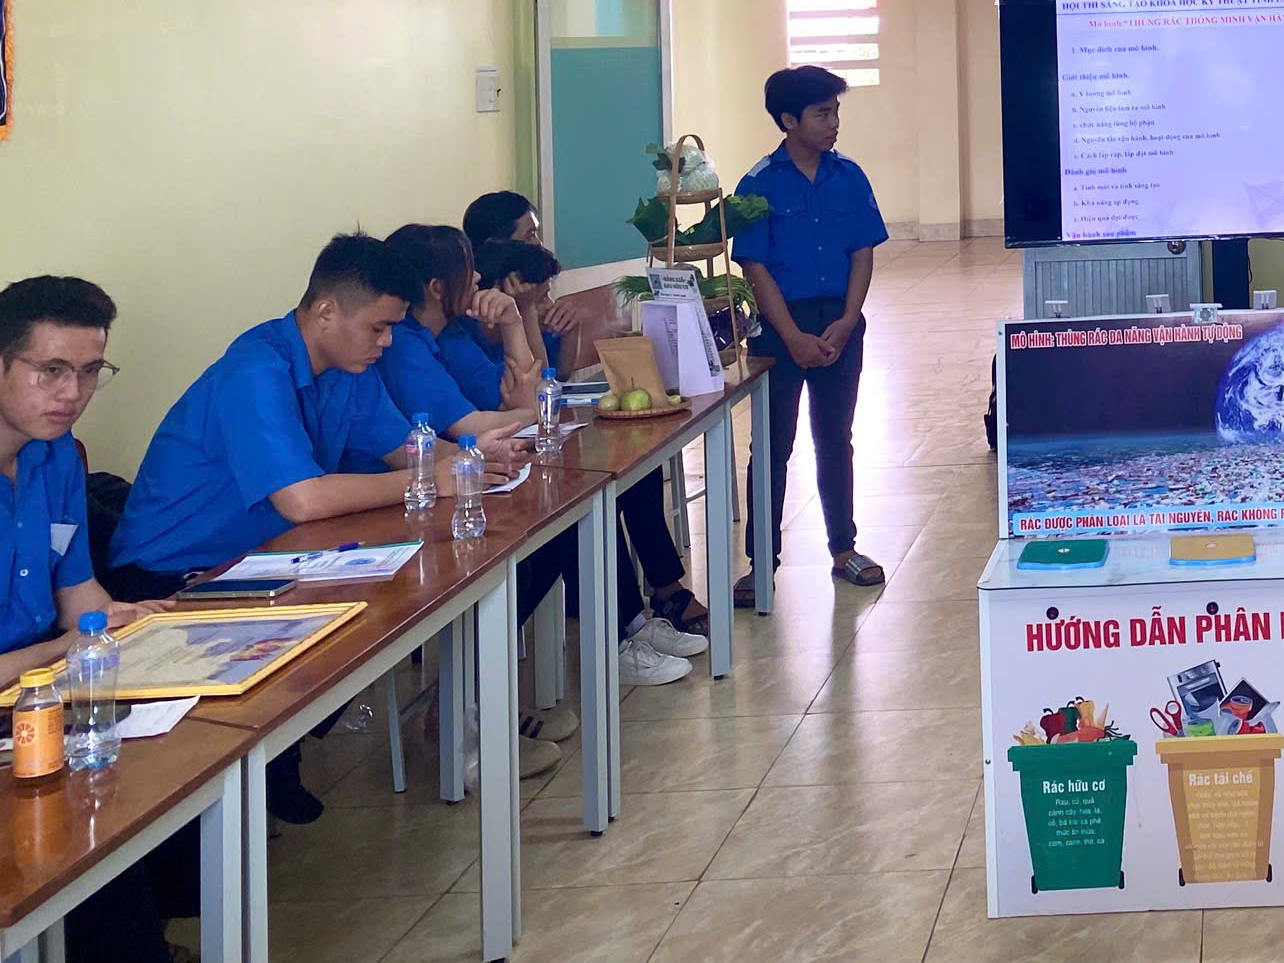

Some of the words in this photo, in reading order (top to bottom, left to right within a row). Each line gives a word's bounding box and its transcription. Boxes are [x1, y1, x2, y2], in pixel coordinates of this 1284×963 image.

[1062, 2, 1080, 11] HỘI
[1082, 1, 1098, 9] THI
[1221, 15, 1246, 24] MINH
[1011, 331, 1027, 349] MÔ
[1055, 328, 1086, 347] THÙNG
[1088, 327, 1108, 346] RÁC
[1109, 329, 1123, 345] ĐA
[1124, 326, 1151, 344] NĂNG
[1152, 325, 1173, 346] VẬN
[1174, 324, 1201, 342] HÀNH
[1202, 325, 1216, 345] TỰ
[1215, 323, 1243, 343] ĐỘNG
[1021, 516, 1041, 530] RÁC
[1044, 517, 1072, 532] ĐƯỢC
[1076, 513, 1104, 528] PHÂN
[1107, 514, 1130, 528] LOẠI
[1133, 511, 1146, 526] LÀ
[1149, 511, 1165, 525] TÀI
[1217, 506, 1238, 522] RÁC
[1242, 506, 1277, 521] KHÔNG
[1026, 615, 1120, 652] HƯỚNG
[1129, 605, 1187, 647] DẪN
[1195, 607, 1271, 643] PHÂN
[1043, 780, 1064, 793] Rác
[1068, 779, 1088, 792] hữu
[1092, 779, 1106, 791] cơ
[1189, 773, 1210, 786] Rác
[1233, 769, 1253, 784] chế
